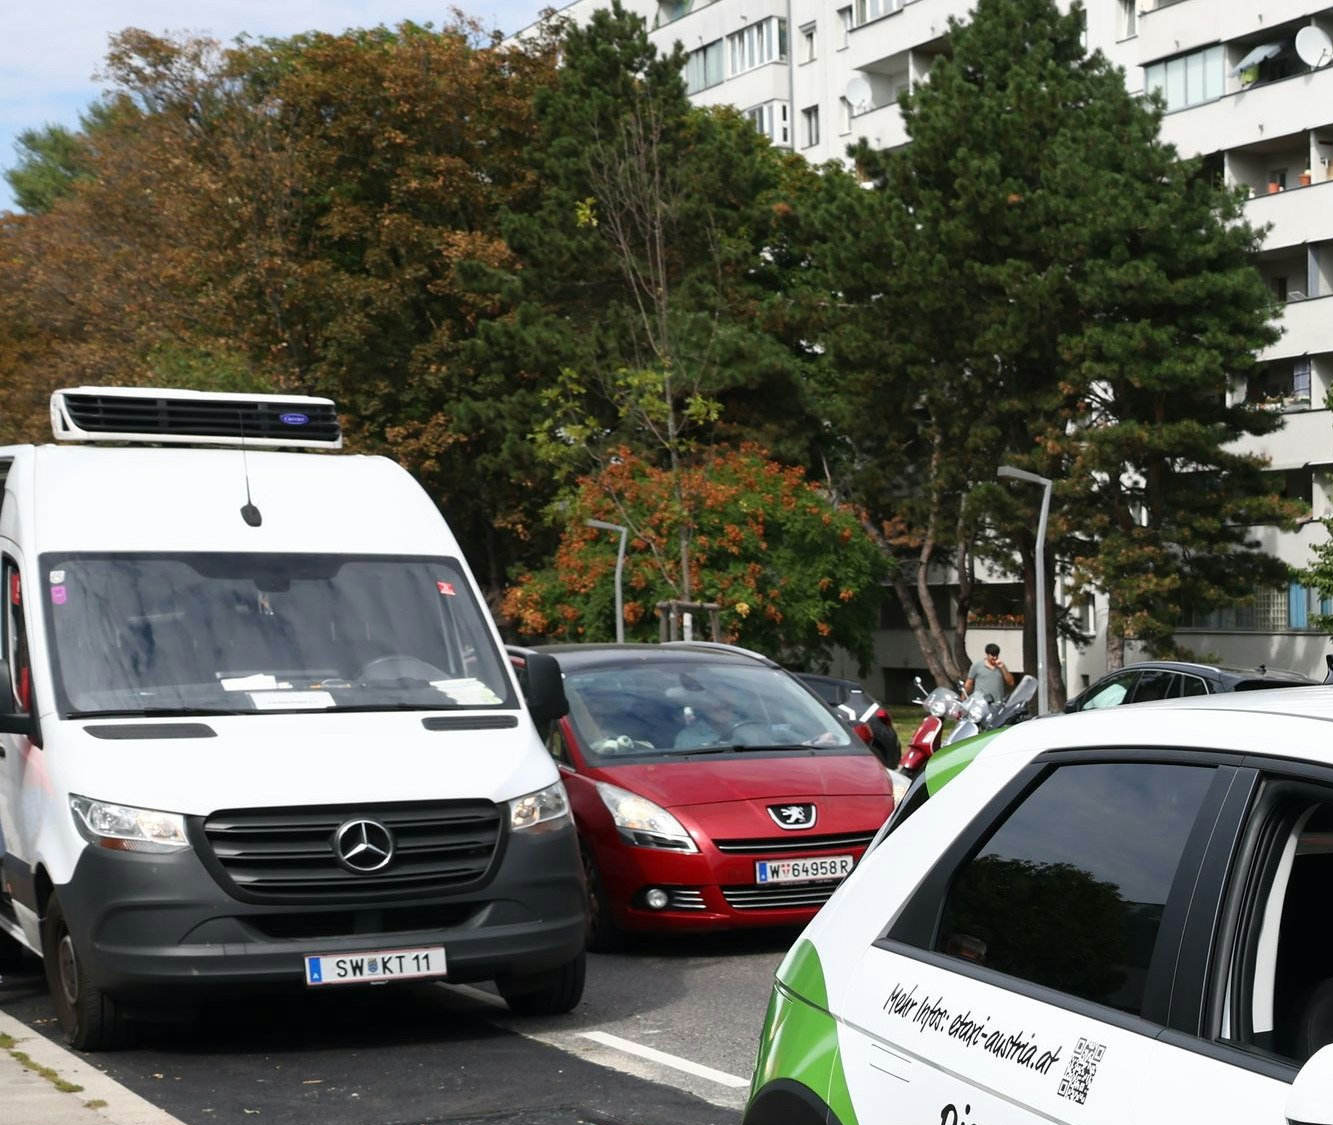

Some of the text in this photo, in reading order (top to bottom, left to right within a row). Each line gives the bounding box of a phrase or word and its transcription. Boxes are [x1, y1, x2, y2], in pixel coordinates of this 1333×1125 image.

[770, 864, 780, 879] W
[791, 861, 837, 877] 64958
[840, 860, 848, 874] R
[336, 958, 364, 978] SW
[382, 955, 405, 974] KT
[412, 953, 430, 972] 11
[883, 983, 1063, 1075] Mehr Infos: etaxi-austria.at
